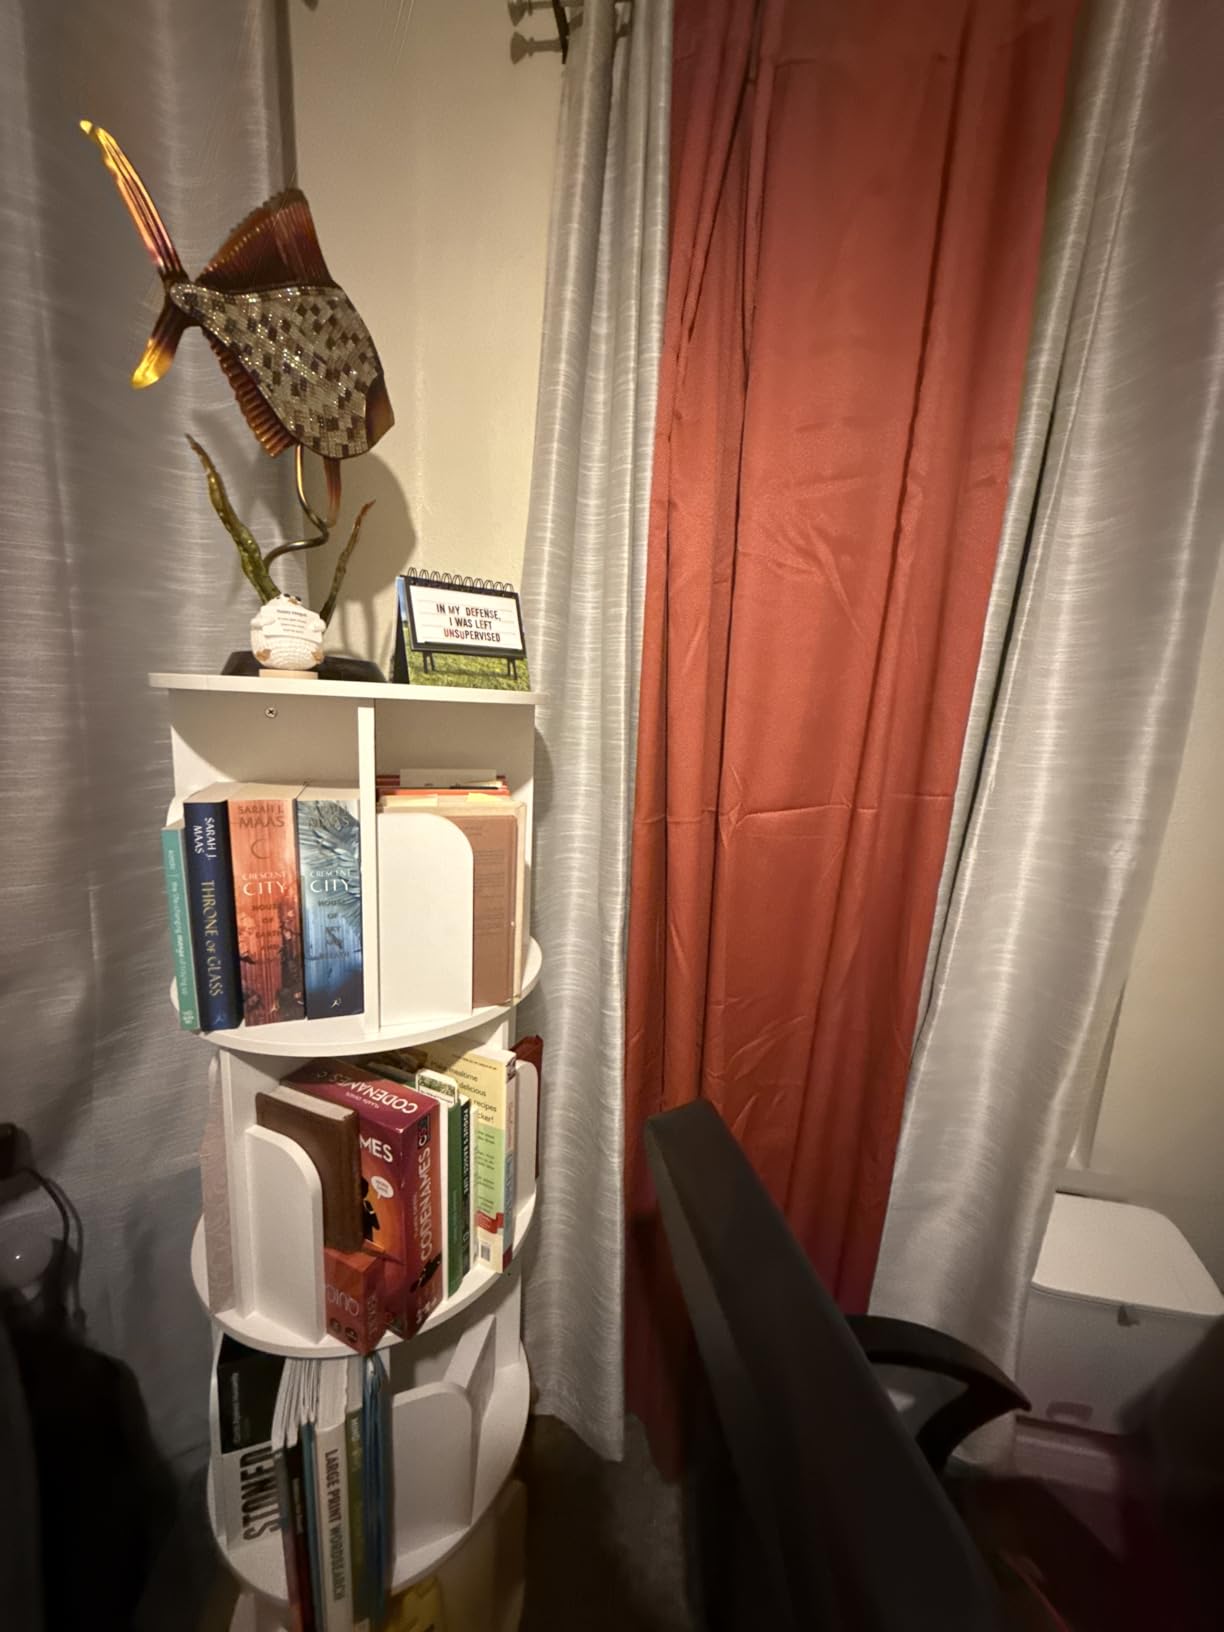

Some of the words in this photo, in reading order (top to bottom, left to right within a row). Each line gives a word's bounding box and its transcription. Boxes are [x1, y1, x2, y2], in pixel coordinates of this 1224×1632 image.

[436, 603, 446, 614] IN
[448, 605, 460, 616] MY
[465, 607, 502, 622] DEFENSE,
[449, 617, 453, 626] I
[454, 618, 473, 628] WAS
[475, 620, 493, 630] LEFT
[443, 628, 501, 642] UNSUPERVISED
[238, 804, 274, 815] SARAH
[239, 815, 286, 829] MAAS
[193, 825, 205, 854] MAAS
[204, 817, 217, 850] SARAH
[205, 853, 217, 861] J.
[241, 870, 287, 881] CRESCENT
[243, 880, 288, 896] CITY
[309, 879, 351, 893] CITY
[201, 880, 219, 937] THRONE
[207, 957, 224, 997] GLASS
[329, 1073, 419, 1114] CODENAMES
[473, 1099, 497, 1113] recipes
[418, 1146, 433, 1261] CODENAMES
[325, 1448, 340, 1489] LARGE
[327, 1488, 343, 1524] PRINT
